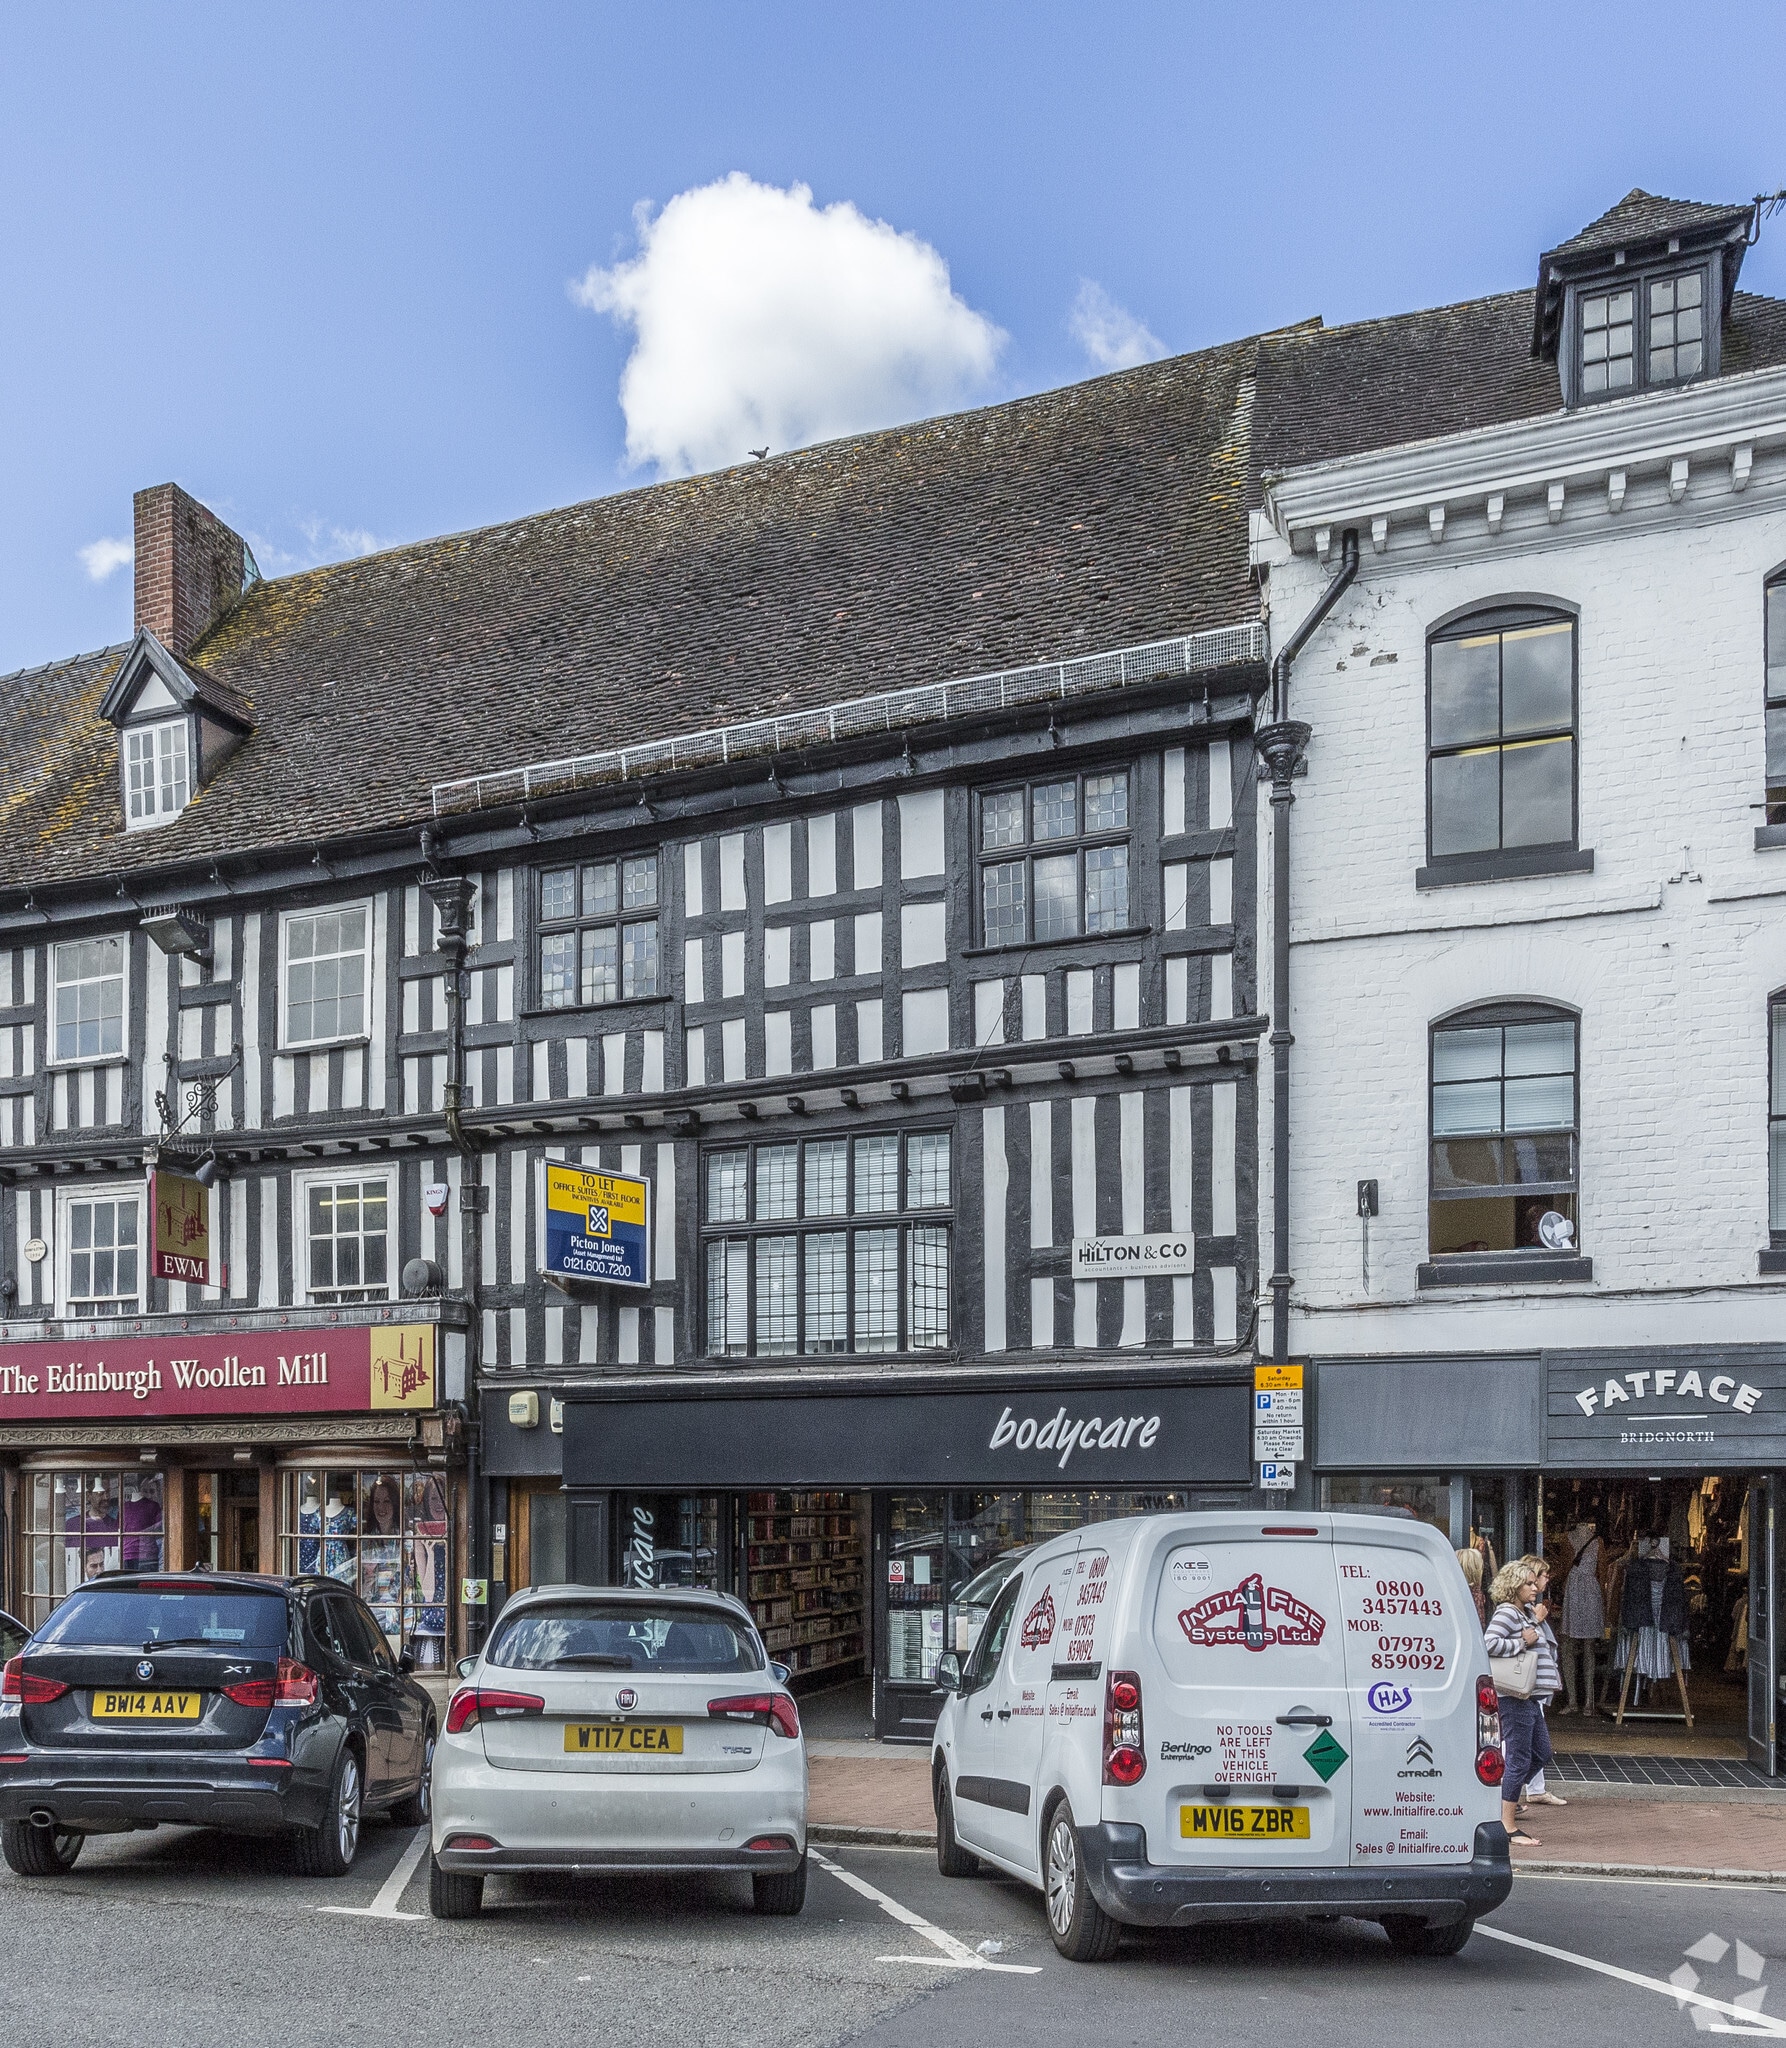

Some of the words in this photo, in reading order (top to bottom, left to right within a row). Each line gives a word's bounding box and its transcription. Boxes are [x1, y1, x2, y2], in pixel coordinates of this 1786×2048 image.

[580, 1173, 595, 1187] TO
[598, 1177, 615, 1191] LET
[553, 1181, 575, 1192] OFFICE
[577, 1186, 598, 1197] SUITES
[603, 1191, 618, 1200] FIRST
[620, 1195, 640, 1204] FLOOR
[570, 1235, 599, 1250] Picton
[601, 1240, 625, 1255] Jones
[163, 1255, 204, 1279] EWM
[563, 1256, 631, 1277] 0121.600.7200
[0, 1364, 39, 1394] The
[46, 1359, 162, 1399] Edinburgh
[170, 1356, 266, 1389] Woollen
[277, 1352, 329, 1386] Mill
[1575, 1369, 1763, 1418] FATFACE
[989, 1406, 1161, 1469] bodycare
[1620, 1431, 1715, 1443] BRIDGNORTH
[1088, 1555, 1109, 1579] 0800
[1340, 1565, 1371, 1578] TEL:
[1077, 1581, 1107, 1606] 3457443
[1376, 1580, 1424, 1597] 0800
[1182, 1592, 1261, 1631] INITIAL
[1270, 1591, 1323, 1633] FIRE
[1362, 1598, 1442, 1616] 3457443
[1074, 1614, 1095, 1636] 07973
[1347, 1619, 1383, 1632] MOB:
[1192, 1628, 1273, 1642] Systems
[1281, 1629, 1317, 1642] Ltd.
[1067, 1639, 1094, 1661] 859092
[1378, 1636, 1436, 1653] 07973
[223, 1665, 252, 1674] X1
[1371, 1653, 1445, 1670] 859092
[105, 1695, 146, 1713] BW14
[152, 1696, 188, 1713] AAV
[621, 1693, 633, 1704] FIAT
[578, 1728, 624, 1748] WT17
[630, 1728, 669, 1749] CEA
[1217, 1726, 1233, 1735] NO
[1238, 1726, 1273, 1735] TOOLS
[722, 1746, 751, 1754] TIPO
[1161, 1742, 1212, 1755] Berlingo
[1220, 1738, 1241, 1747] ARE
[1246, 1738, 1271, 1747] LEFT
[1160, 1753, 1195, 1761] Enterprise
[1225, 1749, 1236, 1758] IN
[1241, 1749, 1266, 1759] THIS
[1222, 1761, 1269, 1770] VEHICLE
[1214, 1772, 1277, 1782] OVERNIGHT
[1395, 1791, 1435, 1802] Website:
[1363, 1805, 1464, 1817] www.Initialfire.co.uk
[1193, 1808, 1244, 1833] MV16
[1251, 1809, 1294, 1833] ZBR
[1400, 1829, 1428, 1839] Email:
[1355, 1842, 1383, 1854] Sales
[1386, 1841, 1396, 1855] @
[1398, 1842, 1469, 1854] Initialfire.co.uk
